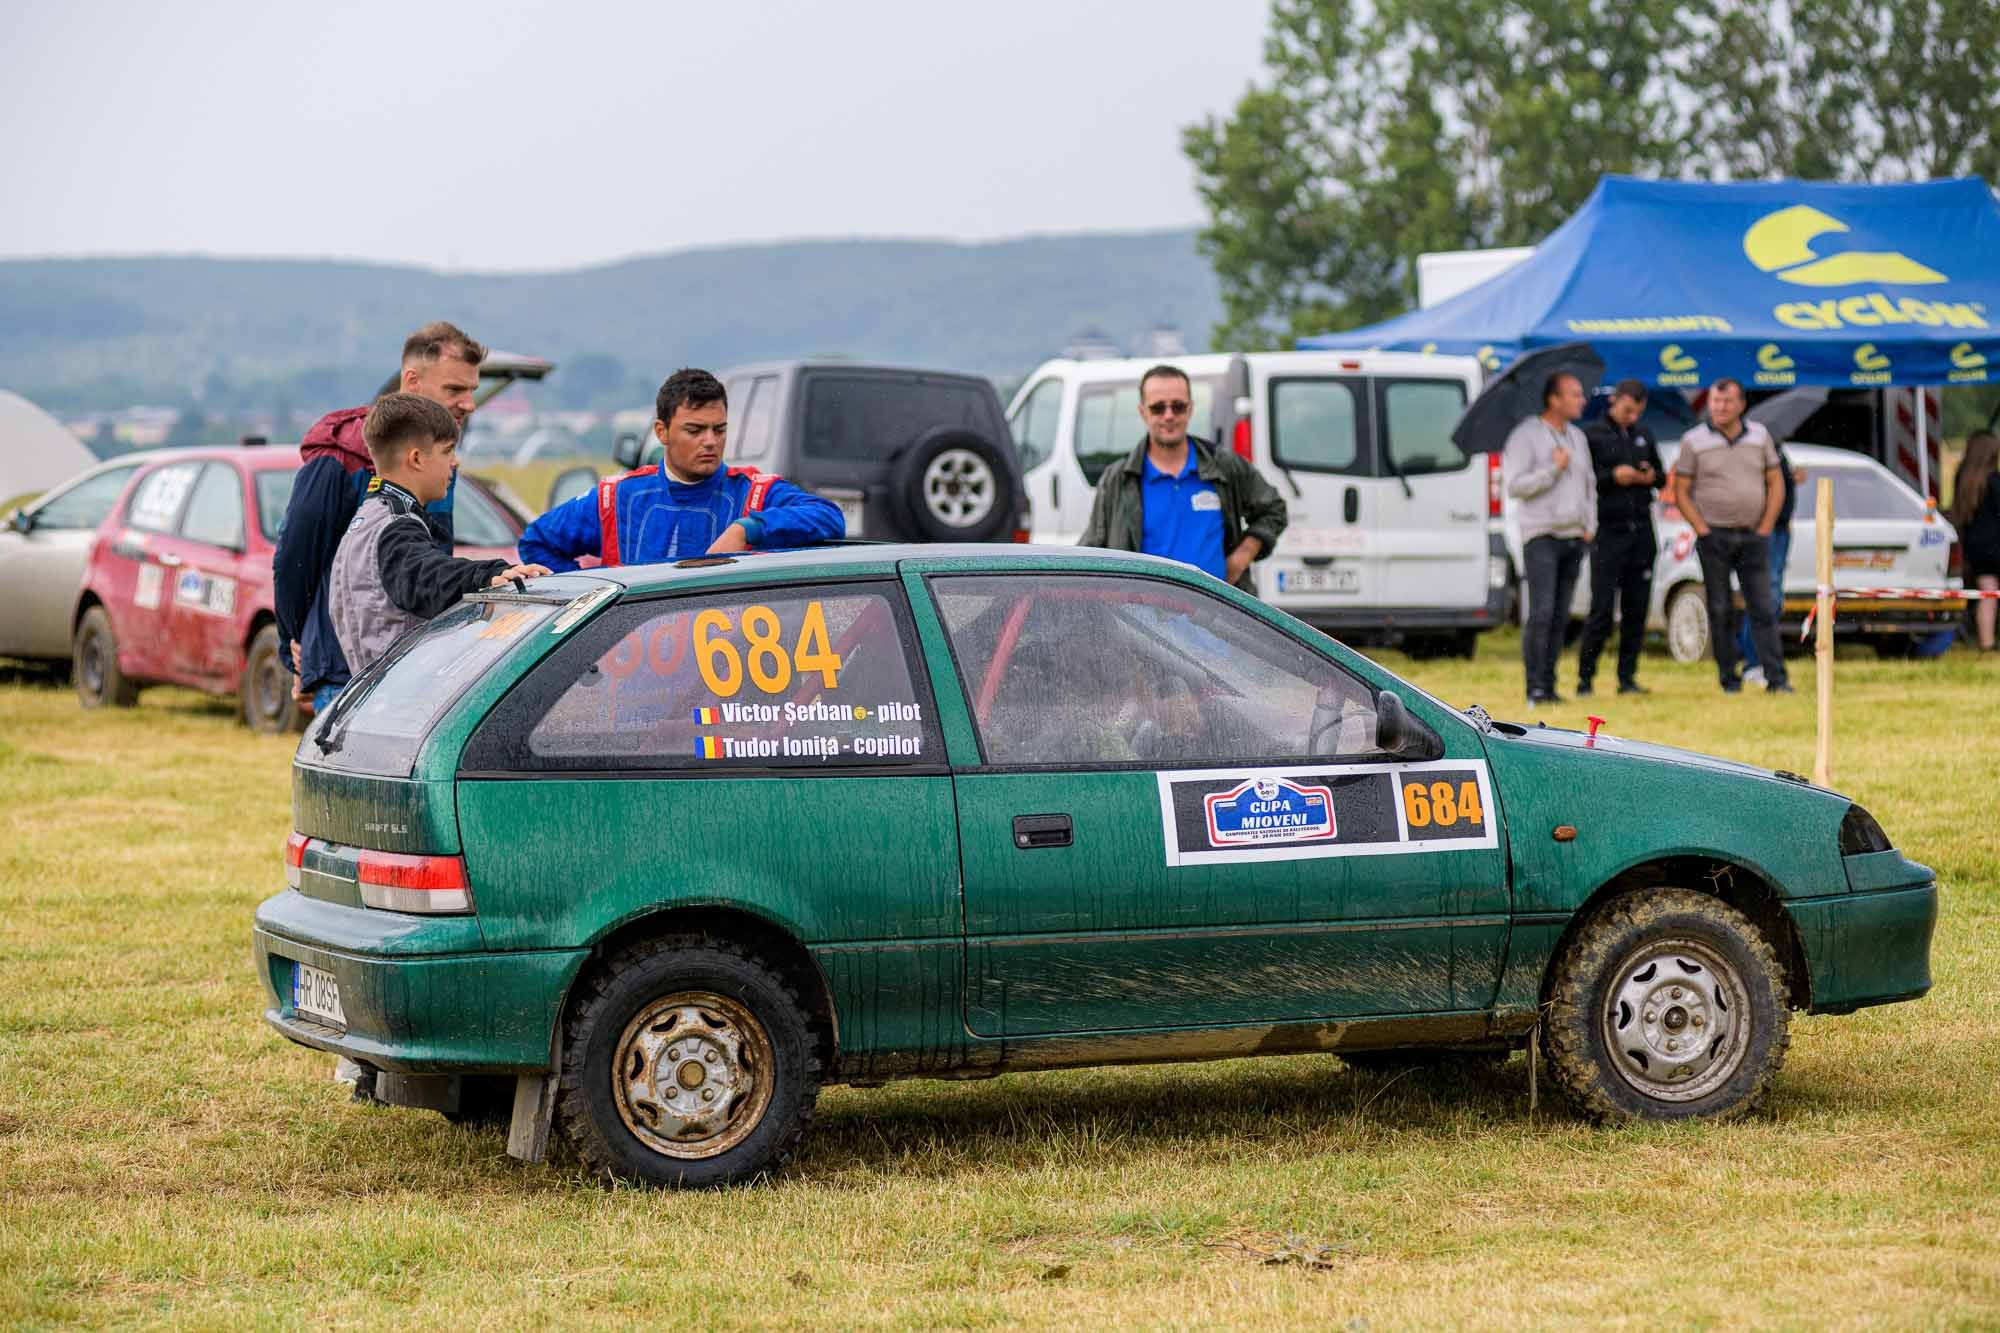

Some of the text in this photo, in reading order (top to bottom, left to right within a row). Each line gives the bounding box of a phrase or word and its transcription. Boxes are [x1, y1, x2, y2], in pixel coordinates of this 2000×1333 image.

[693, 601, 842, 697] 684
[722, 702, 780, 722] Victor
[877, 702, 922, 722] pilot
[723, 737, 779, 757] Tudor
[854, 735, 921, 756] copilot
[1250, 800, 1291, 813] CUPA
[1404, 781, 1483, 827] 684
[1241, 813, 1308, 829] MIOVENI
[300, 967, 313, 1008] HR
